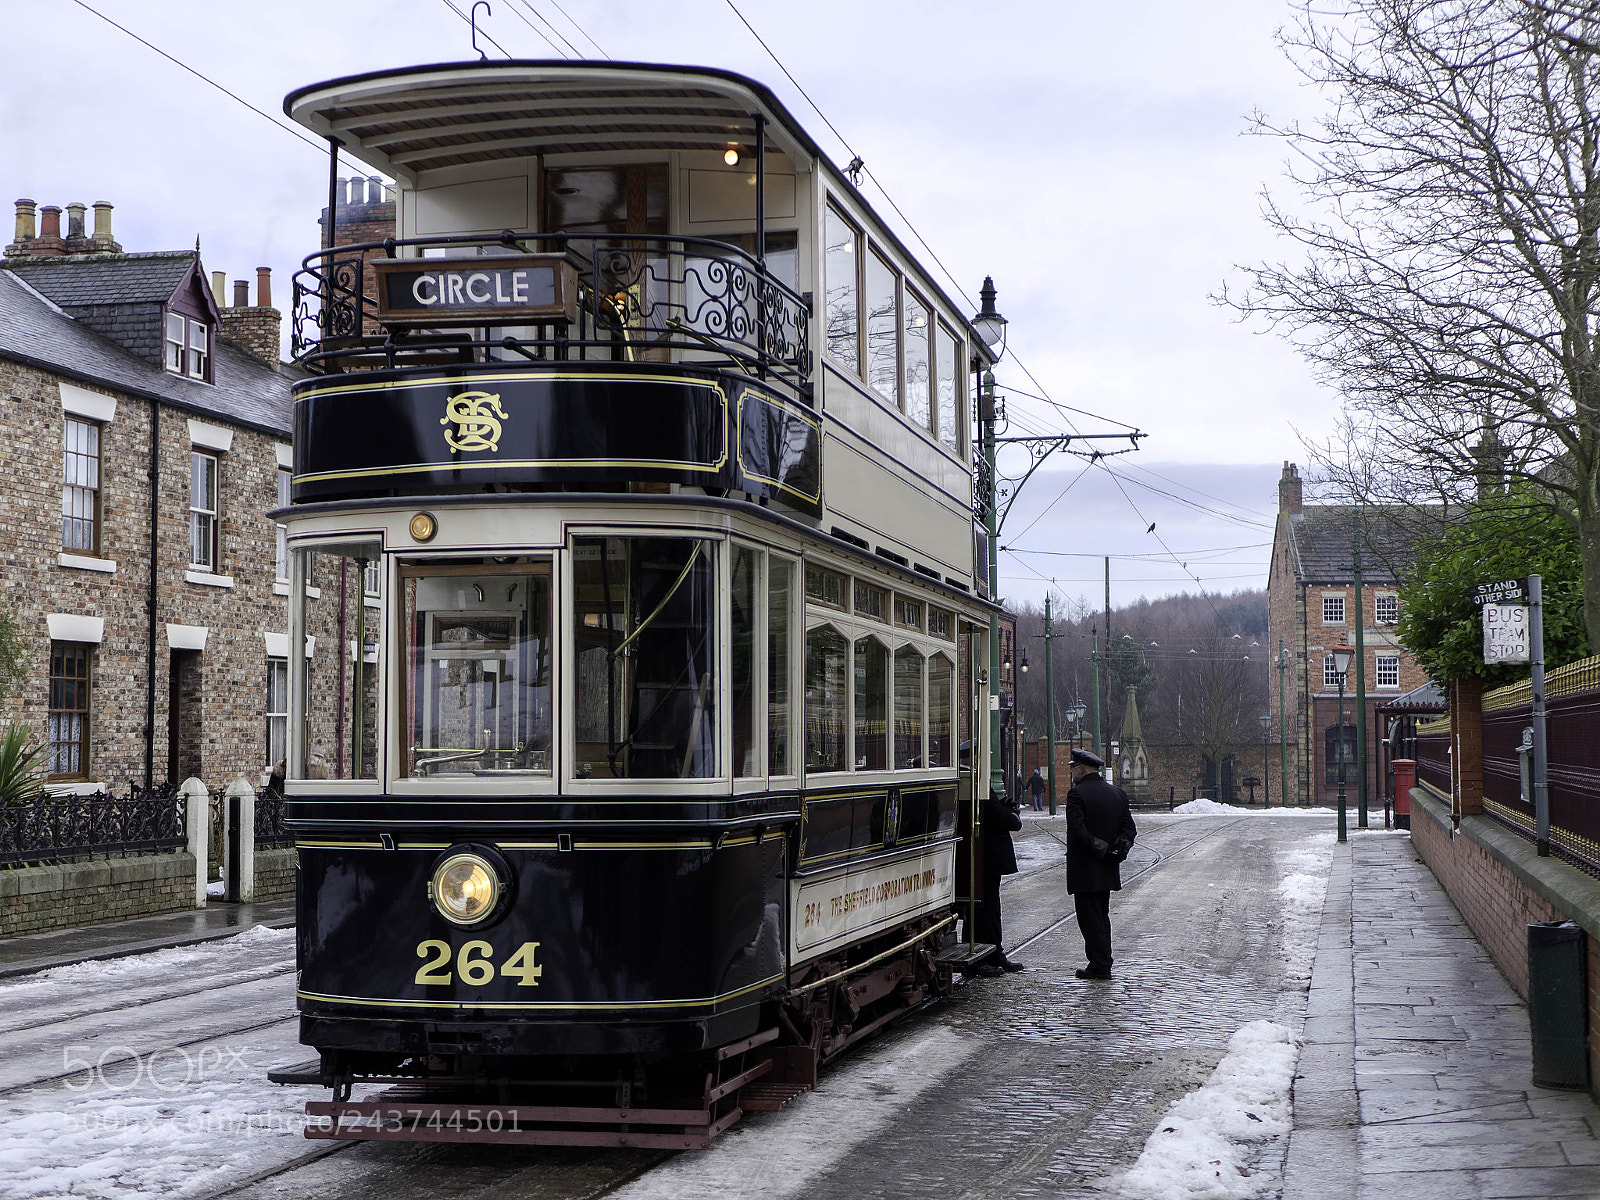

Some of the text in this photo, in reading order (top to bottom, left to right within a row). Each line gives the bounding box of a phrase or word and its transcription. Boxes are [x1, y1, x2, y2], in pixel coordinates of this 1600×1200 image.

[412, 271, 529, 305] CIRCLE
[1477, 579, 1518, 594] STAND
[1473, 591, 1503, 605] OTHER
[1487, 608, 1523, 623] BUS
[1489, 644, 1525, 658] STOP
[804, 901, 821, 928] 264
[830, 895, 843, 918] THE
[844, 886, 876, 915] SHEFFIELD
[876, 876, 913, 904] CORPORATION
[414, 938, 543, 987] 264
